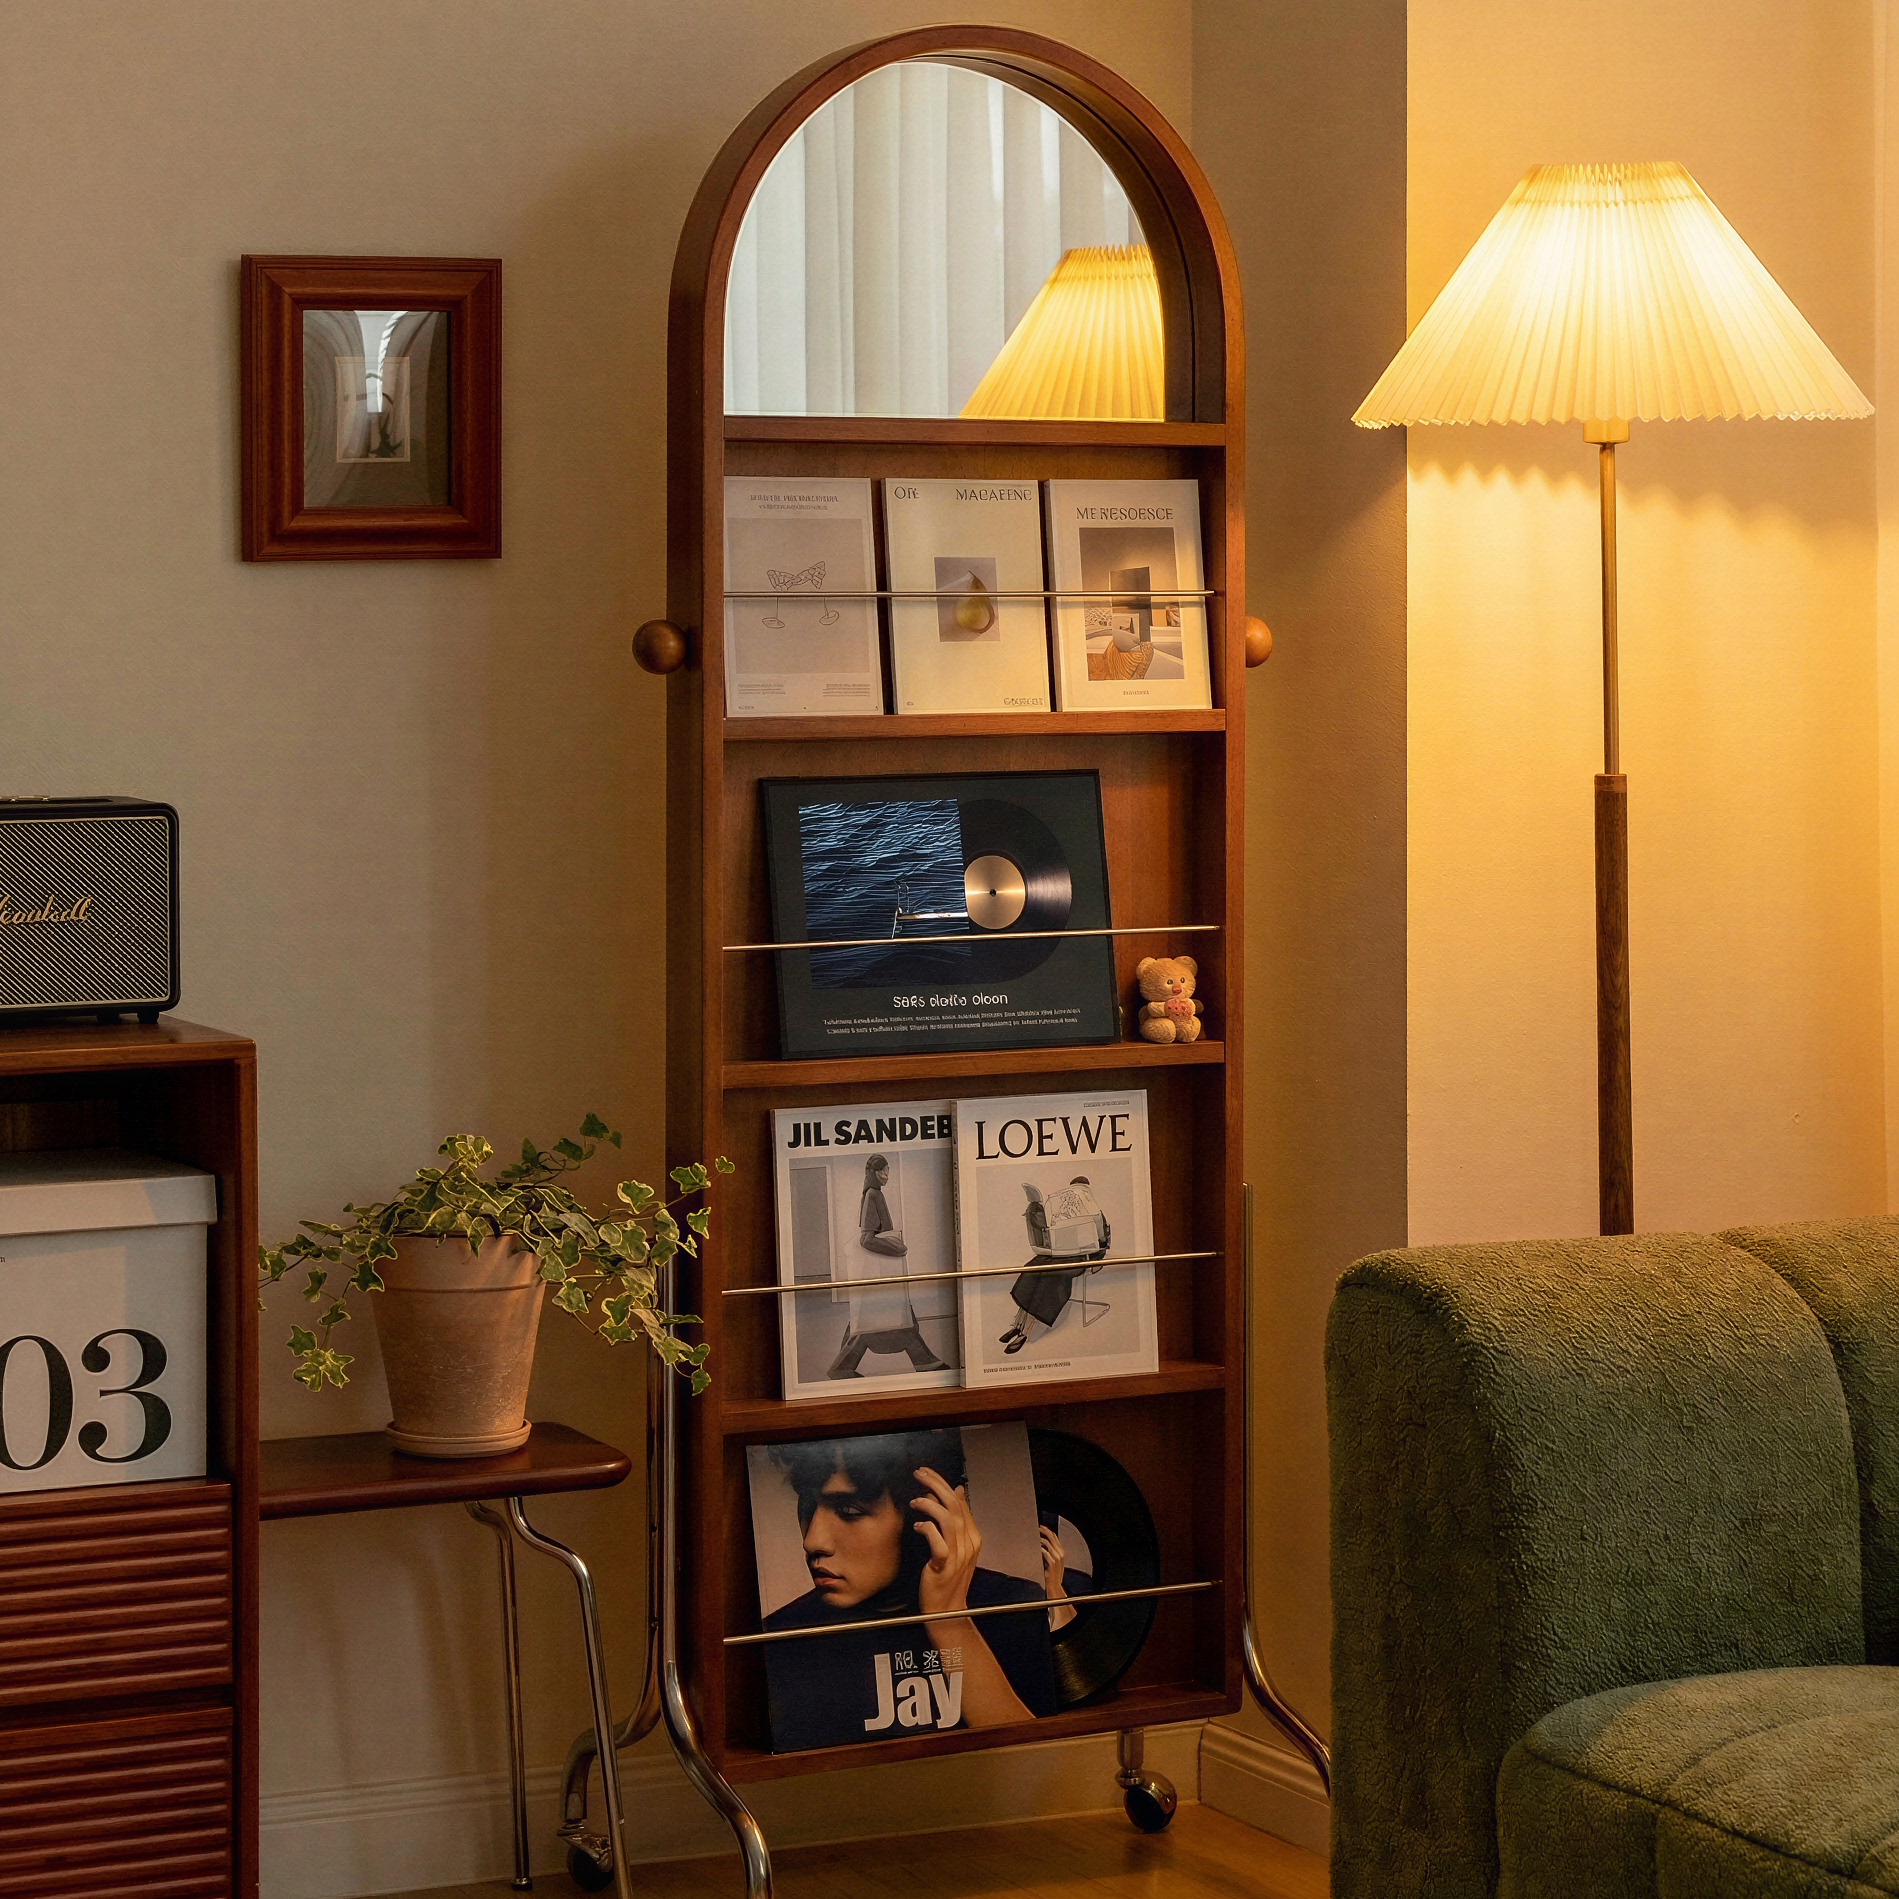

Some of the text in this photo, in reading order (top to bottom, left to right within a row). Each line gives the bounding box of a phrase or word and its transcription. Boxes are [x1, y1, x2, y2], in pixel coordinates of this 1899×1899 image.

[787, 1121, 830, 1149] JIL
[975, 1113, 1133, 1160] LOEWE
[0, 1328, 172, 1471] 03
[864, 1652, 964, 1731] Jay
